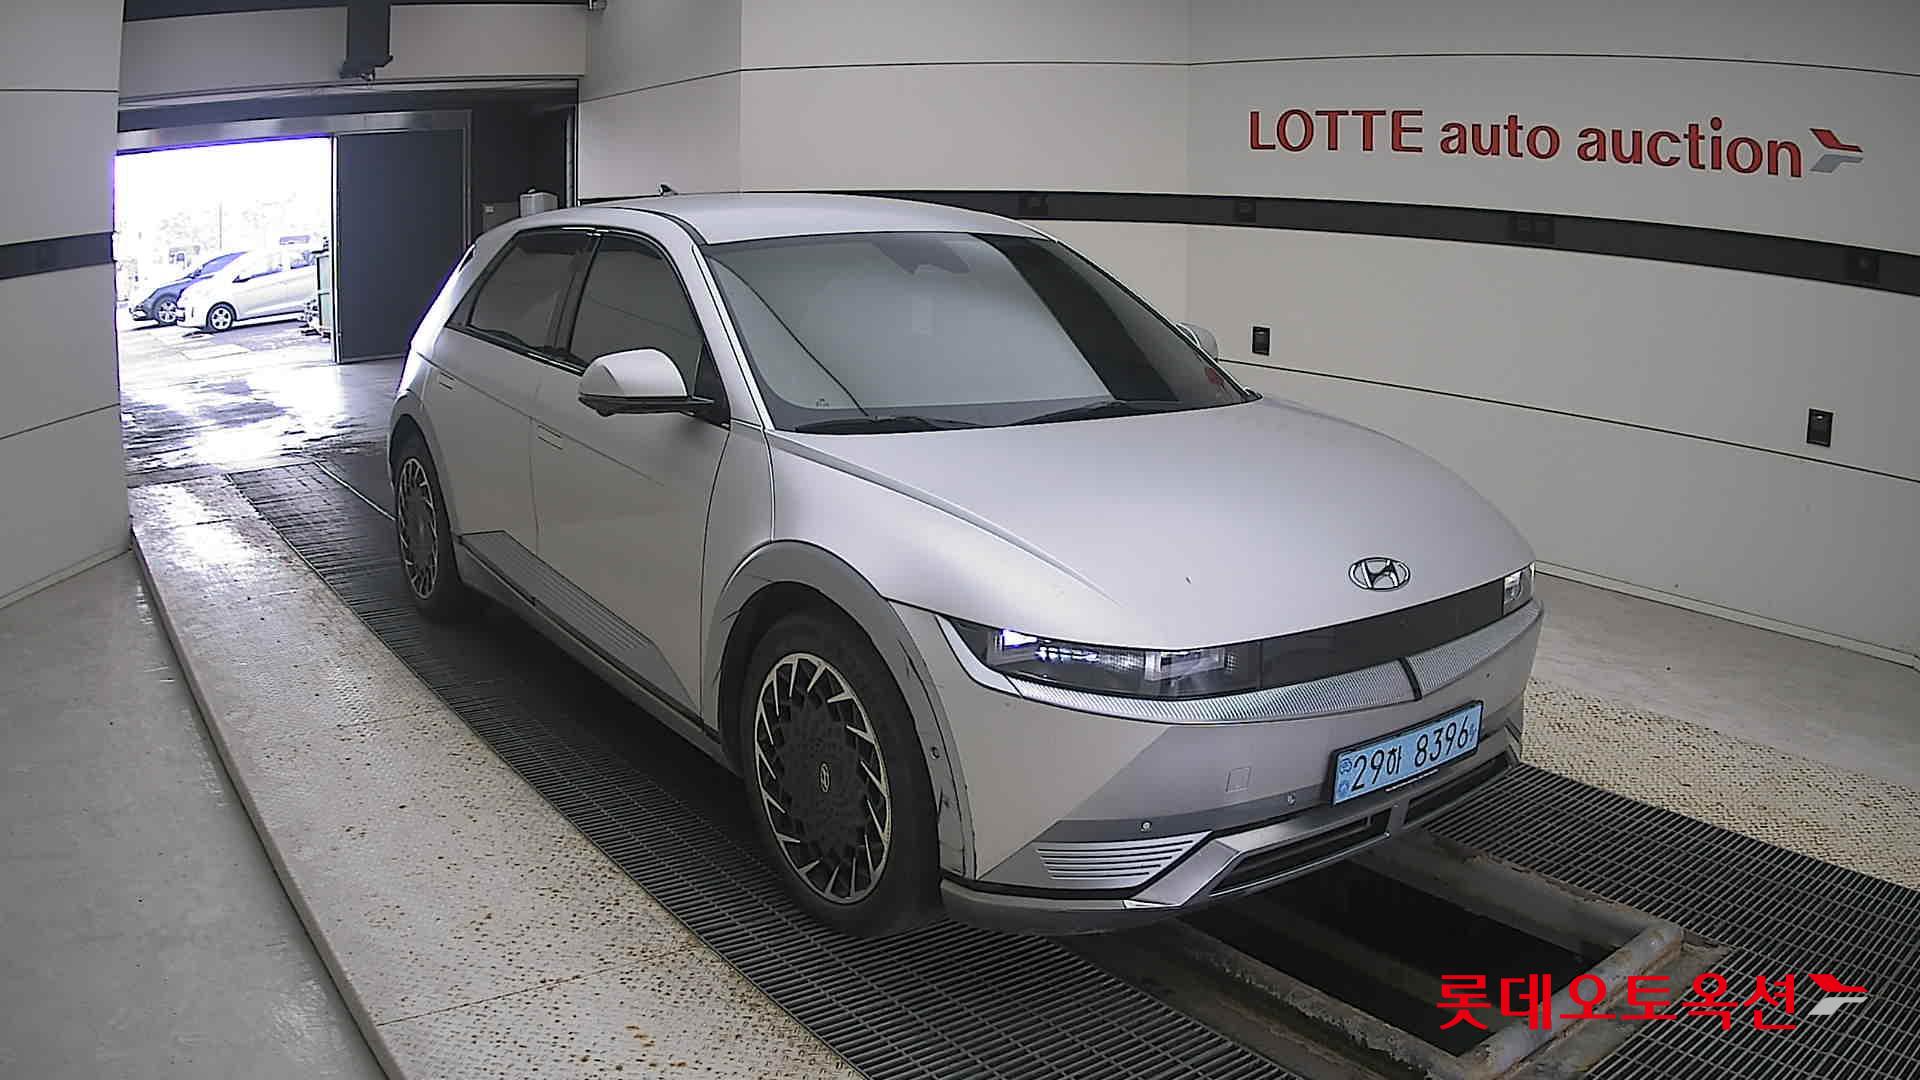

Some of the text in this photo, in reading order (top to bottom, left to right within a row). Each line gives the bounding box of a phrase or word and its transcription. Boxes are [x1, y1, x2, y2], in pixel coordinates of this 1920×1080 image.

[1249, 109, 1804, 178] LOTTE auto auction
[1351, 715, 1469, 792] 29하 8396
